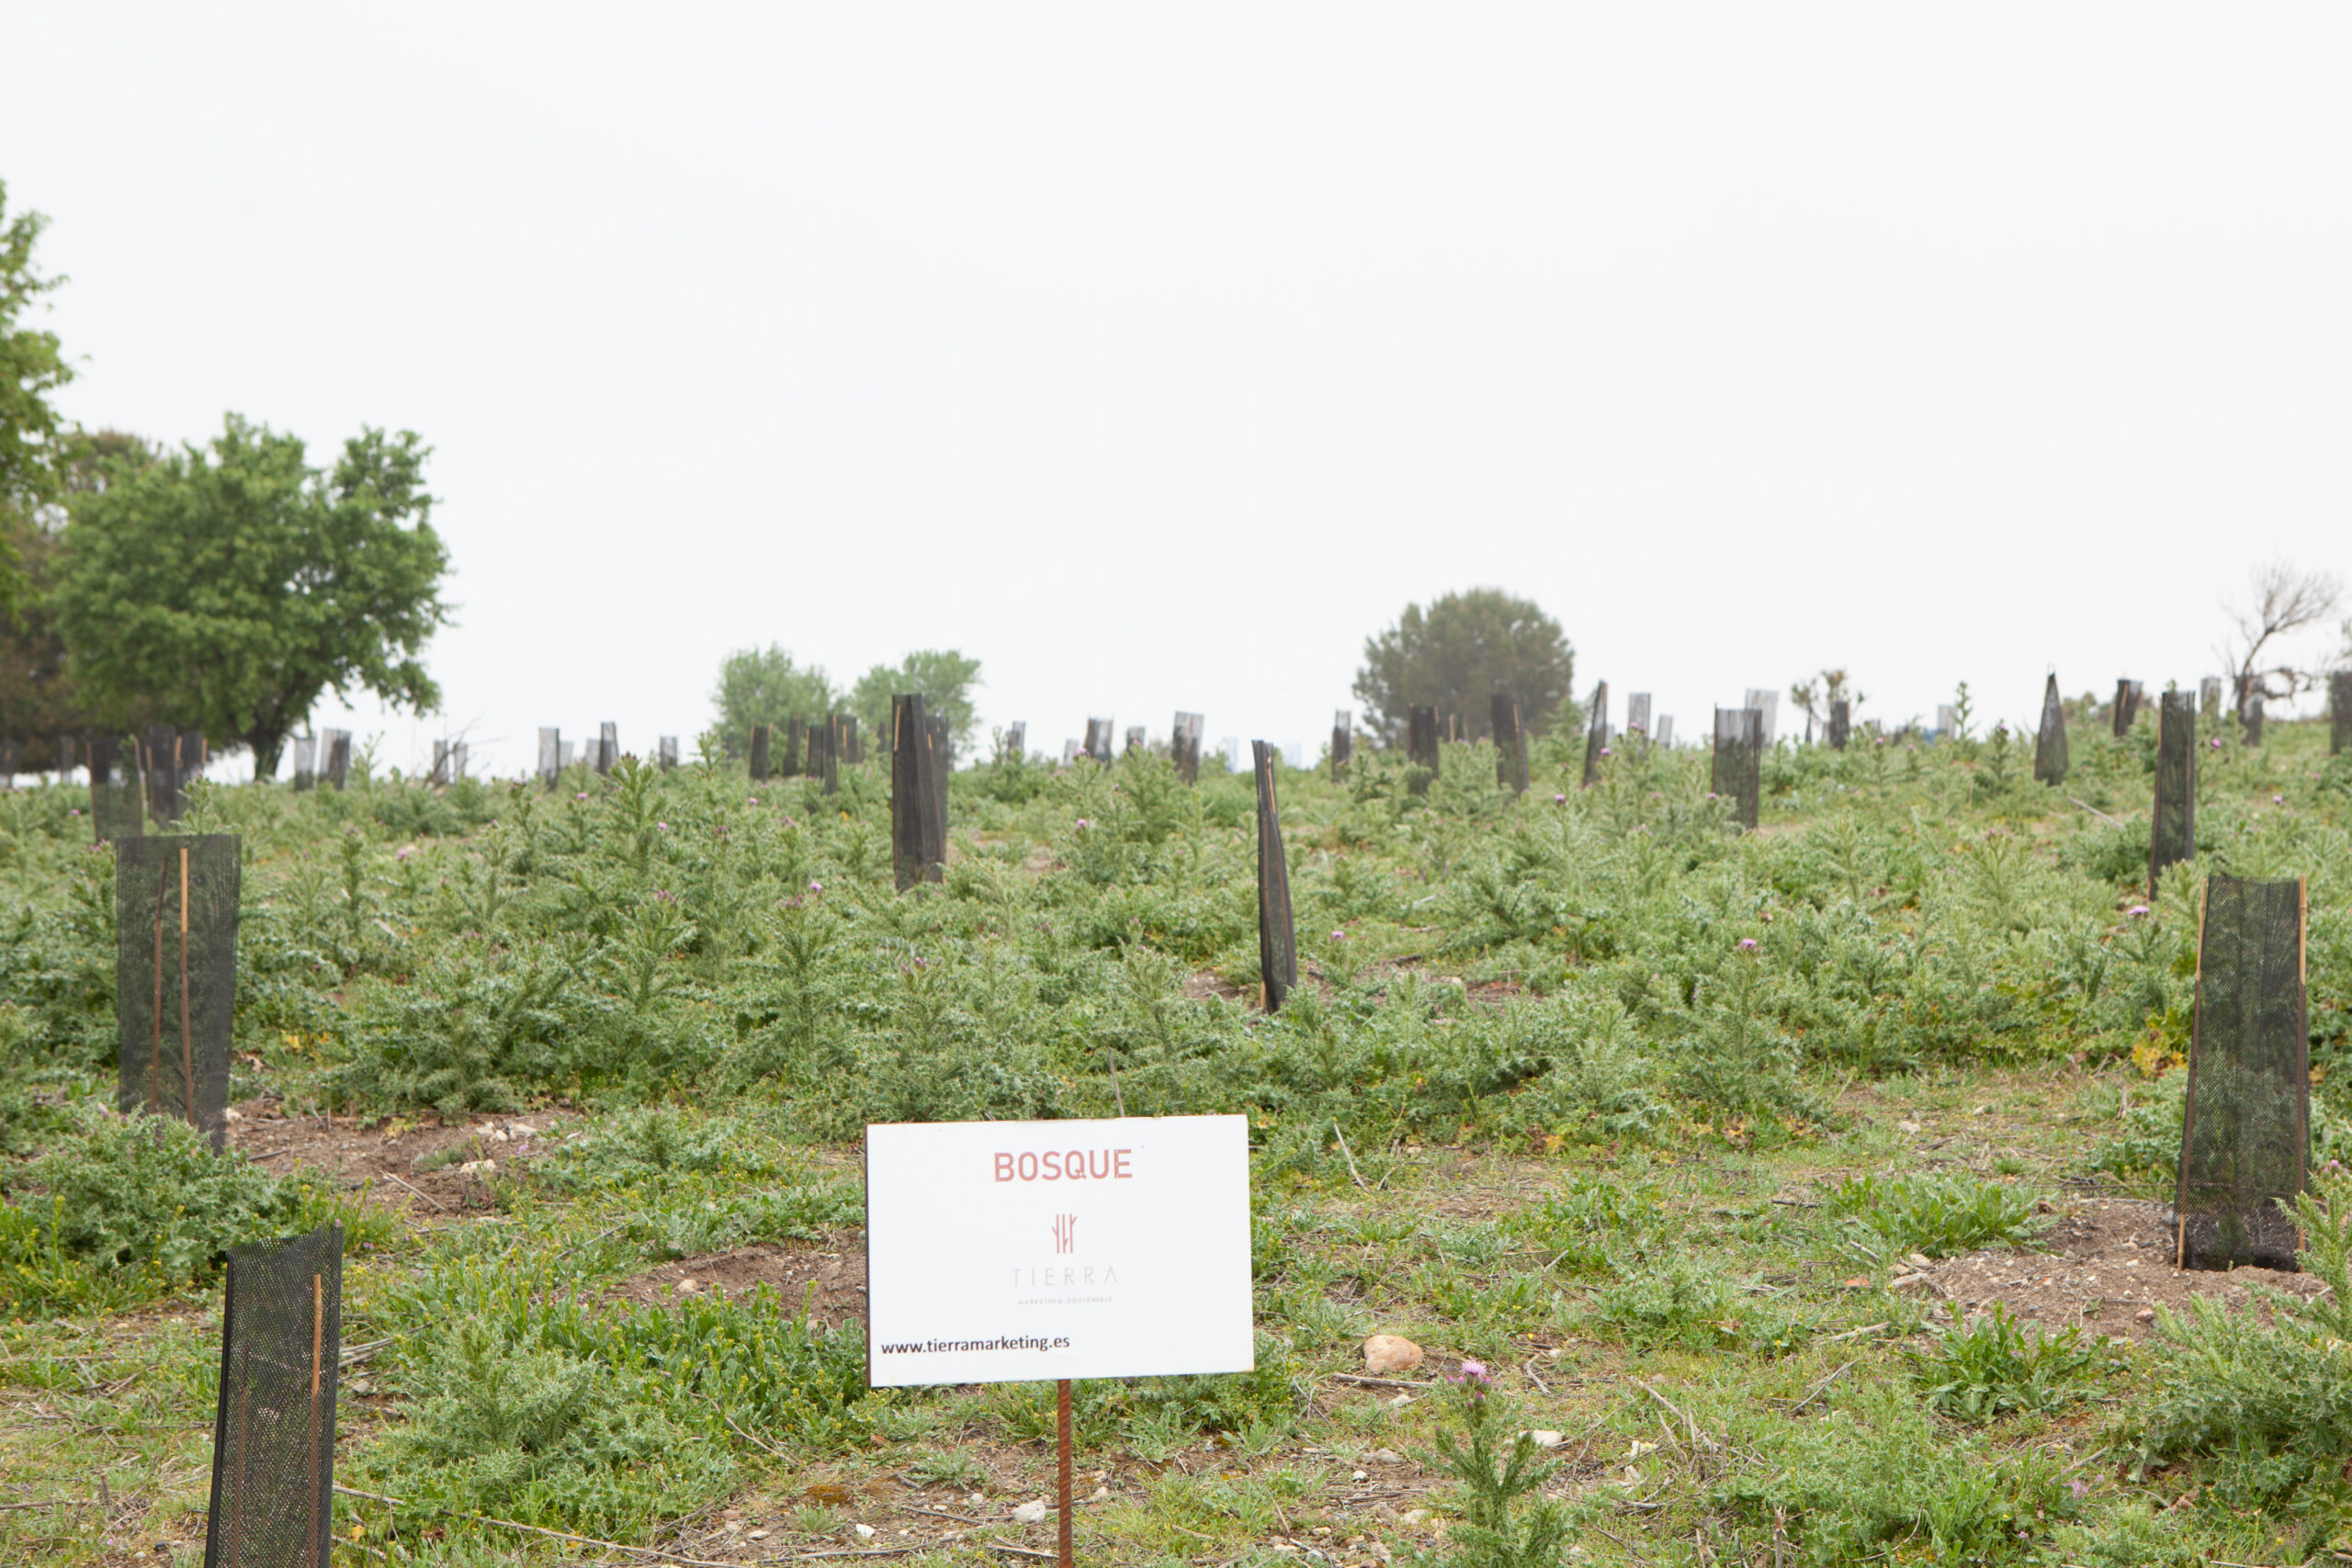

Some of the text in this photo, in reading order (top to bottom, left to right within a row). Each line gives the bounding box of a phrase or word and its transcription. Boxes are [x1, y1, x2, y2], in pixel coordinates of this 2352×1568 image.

[994, 1149, 1132, 1182] BOSQUE
[1012, 1266, 1117, 1287] TIERRA
[881, 1335, 1069, 1354] www.tierramarketing.es
